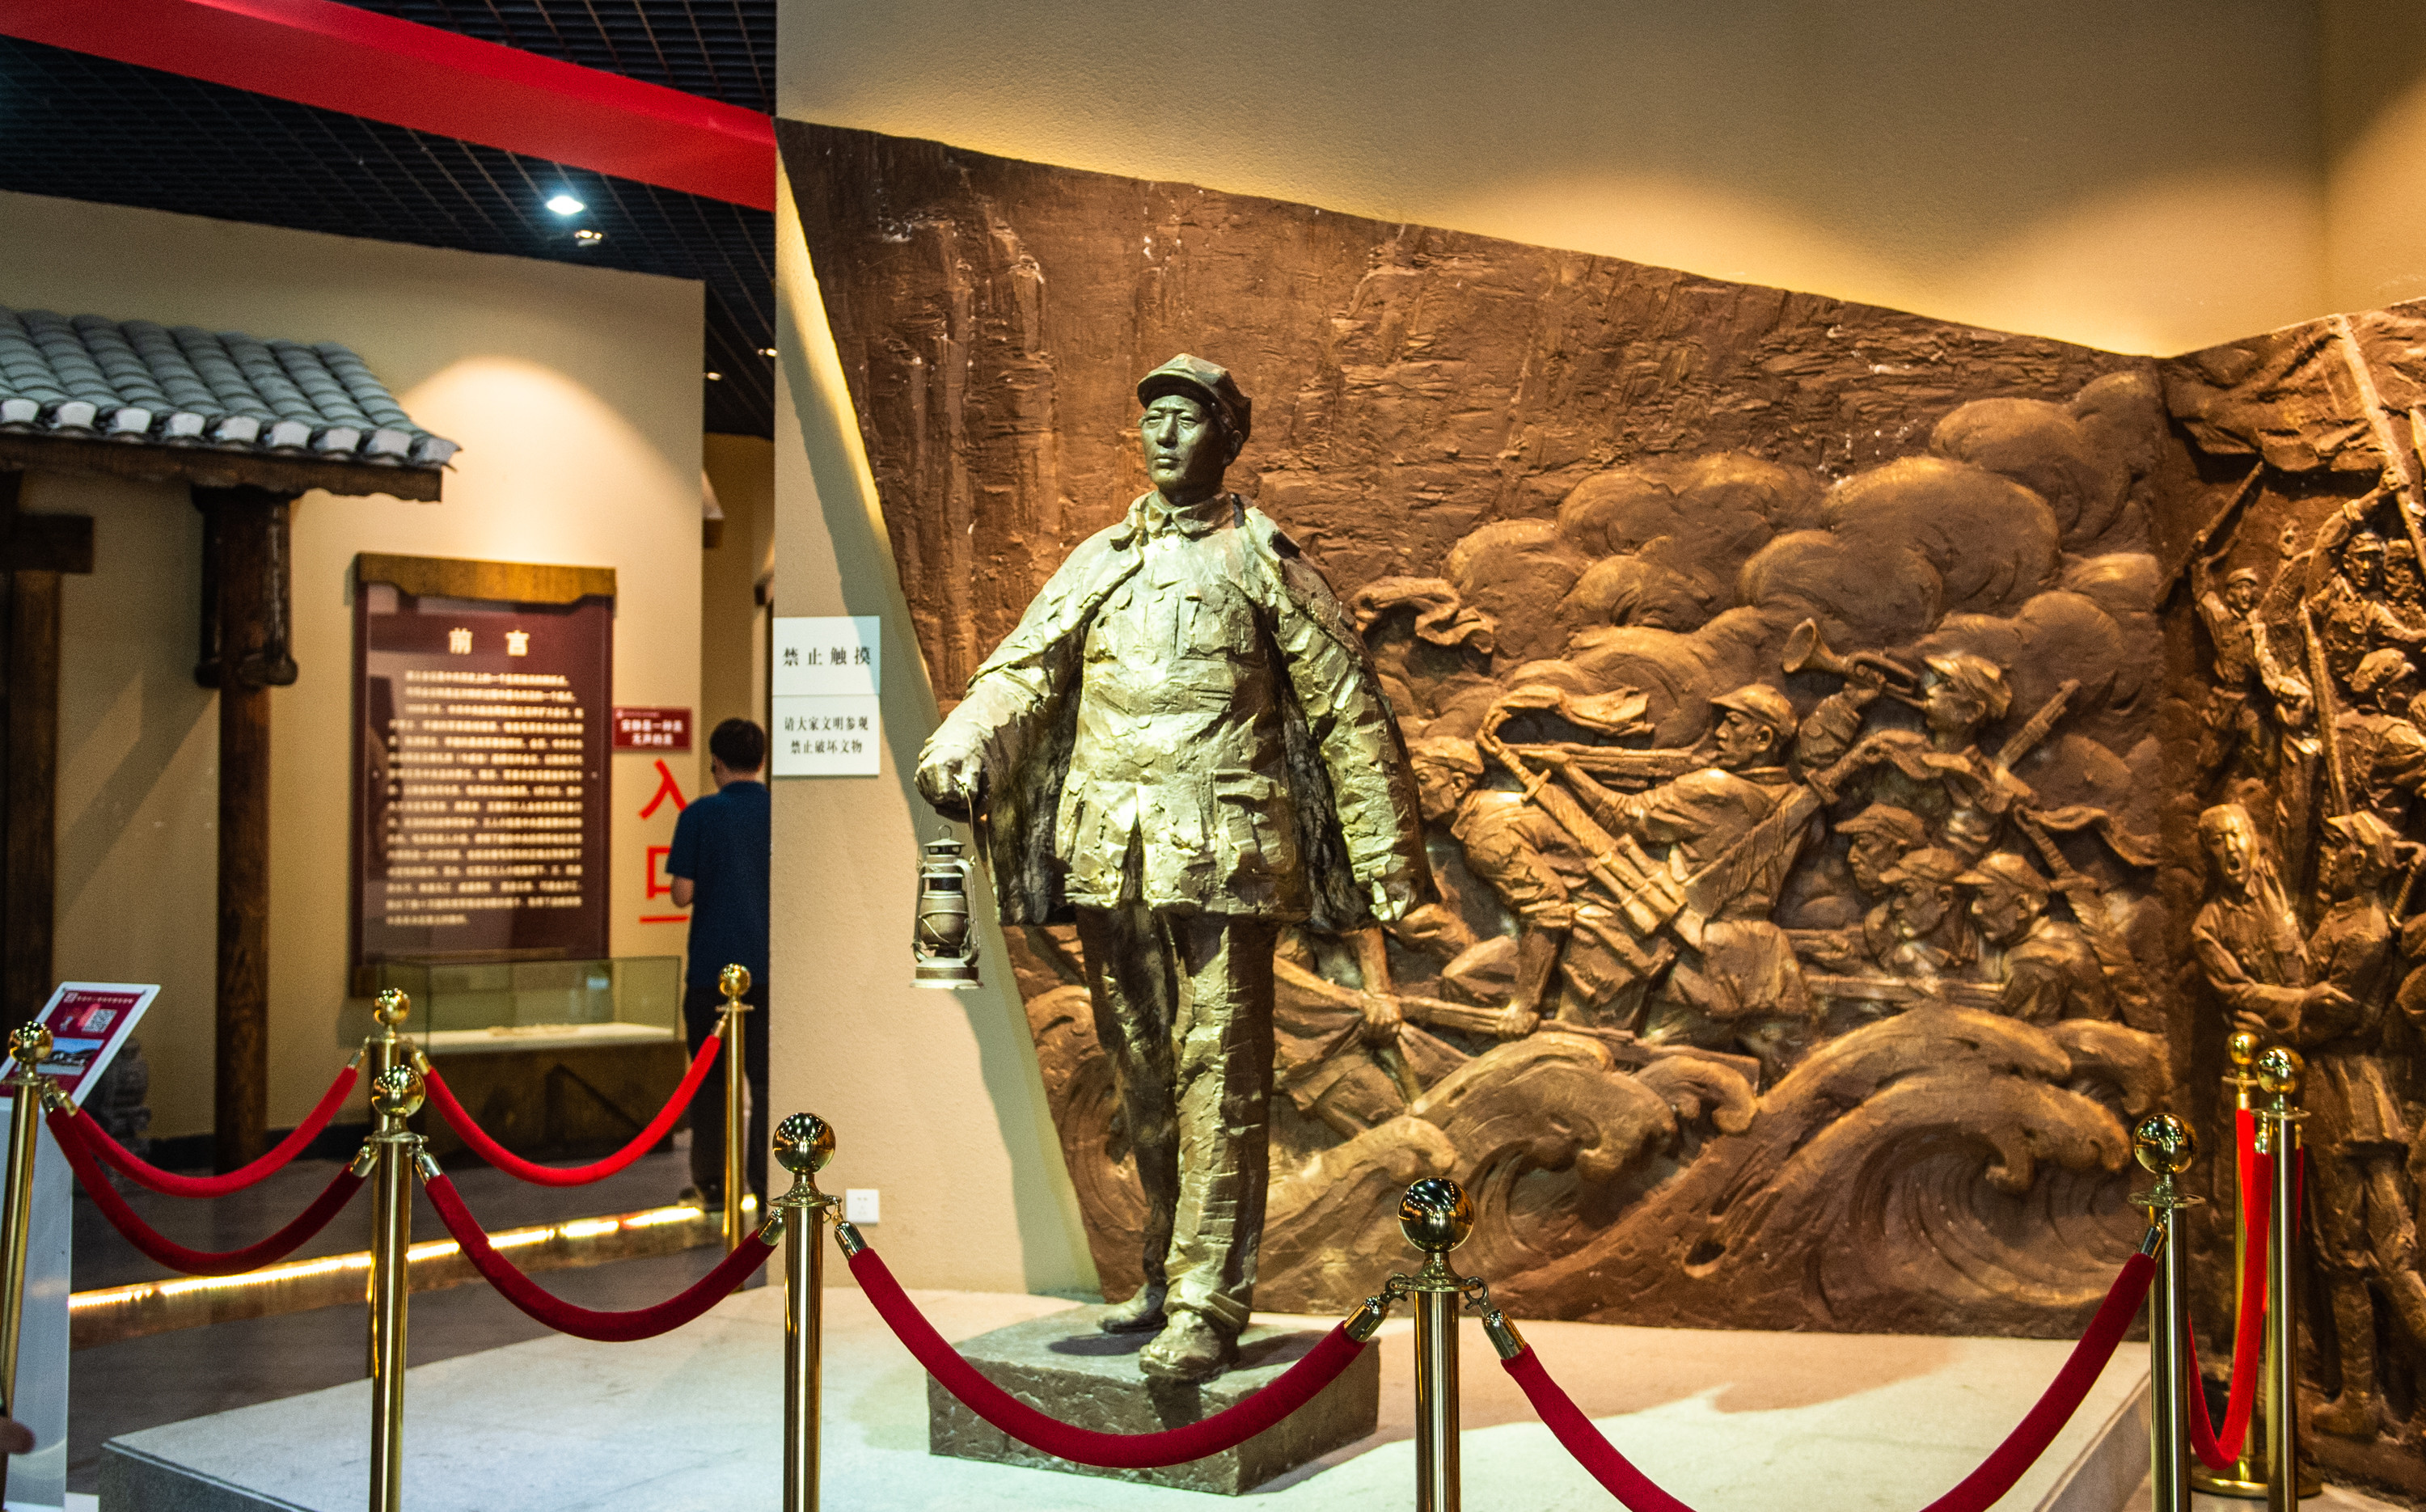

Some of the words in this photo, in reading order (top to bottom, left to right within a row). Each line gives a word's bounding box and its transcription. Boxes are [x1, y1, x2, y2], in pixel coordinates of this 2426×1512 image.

[448, 627, 530, 657] 前言
[783, 646, 871, 666] 禁止触摸
[784, 716, 869, 731] 请大家文明参观
[790, 739, 863, 754] 禁止破坏文物
